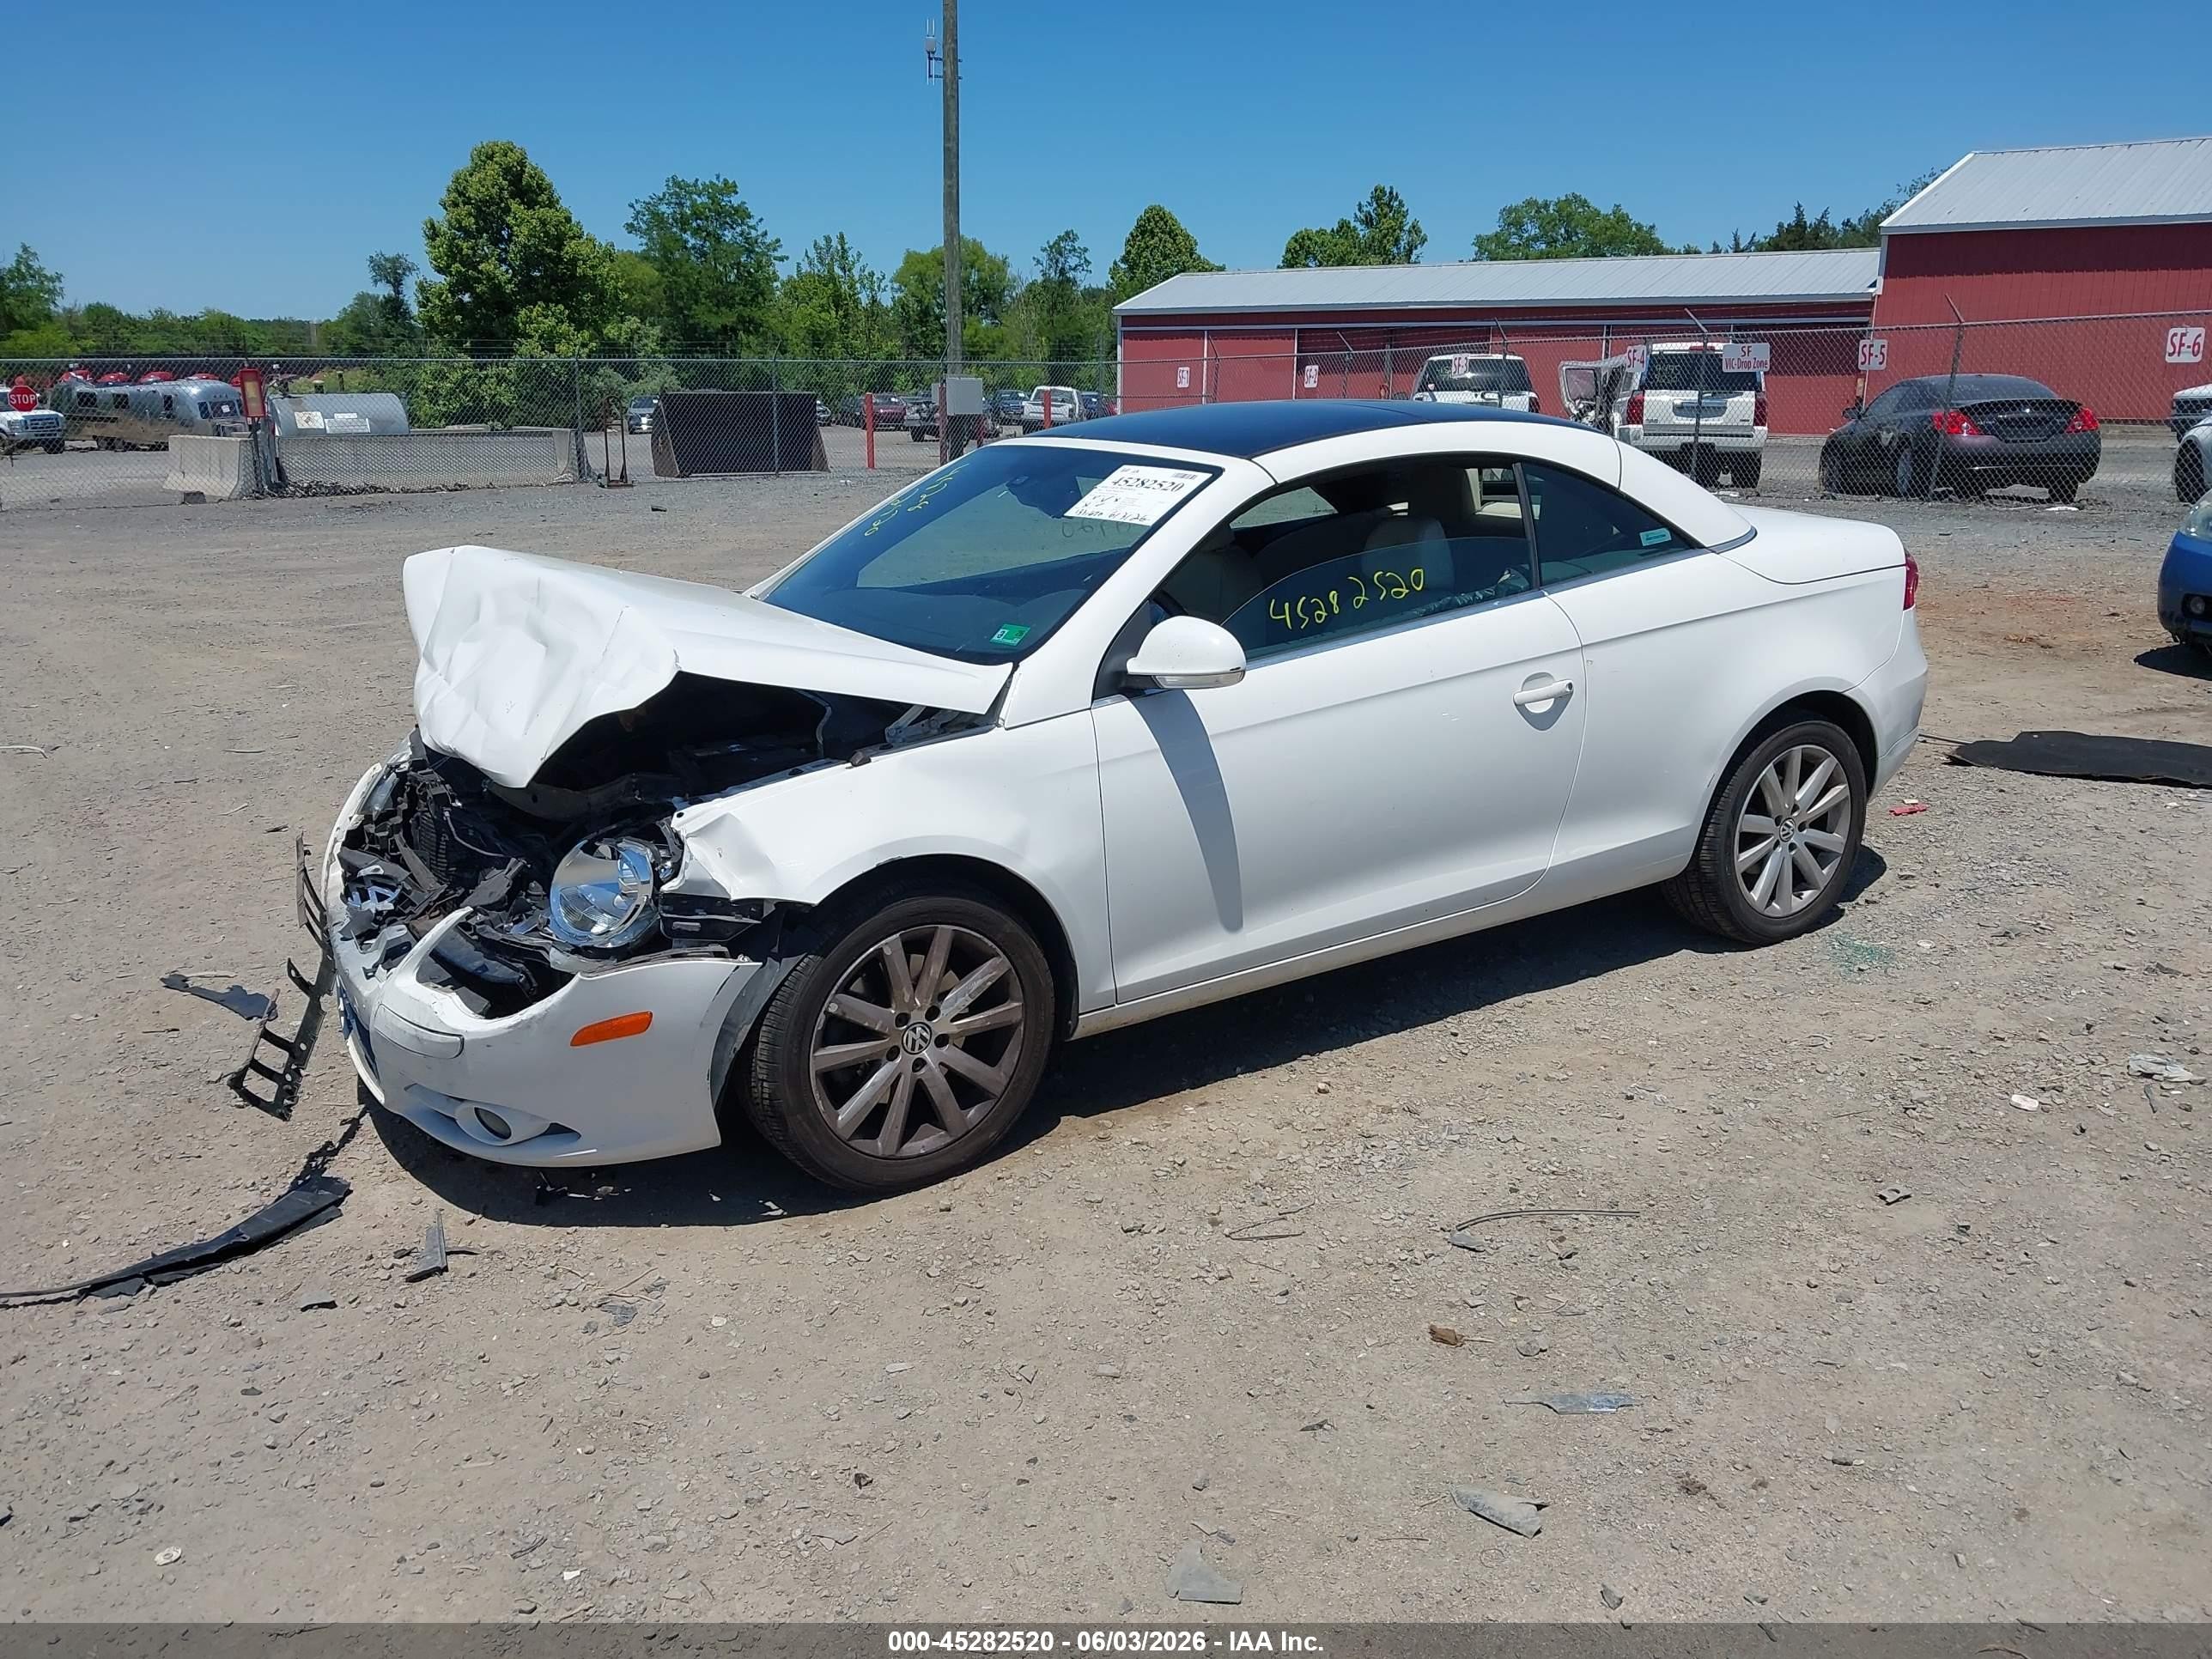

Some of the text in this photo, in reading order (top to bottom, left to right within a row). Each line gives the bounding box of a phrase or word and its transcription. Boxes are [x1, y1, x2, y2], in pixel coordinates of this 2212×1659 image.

[1741, 345, 1752, 357] SF
[2168, 332, 2202, 356] SF-6
[1627, 349, 1644, 368] SF-4
[1861, 343, 1886, 365] SF-5
[1725, 357, 1768, 369] VIC-Drop Zone
[1305, 368, 1317, 385] SF-2
[9, 394, 36, 404] STOP
[1112, 477, 1185, 492] 45282520
